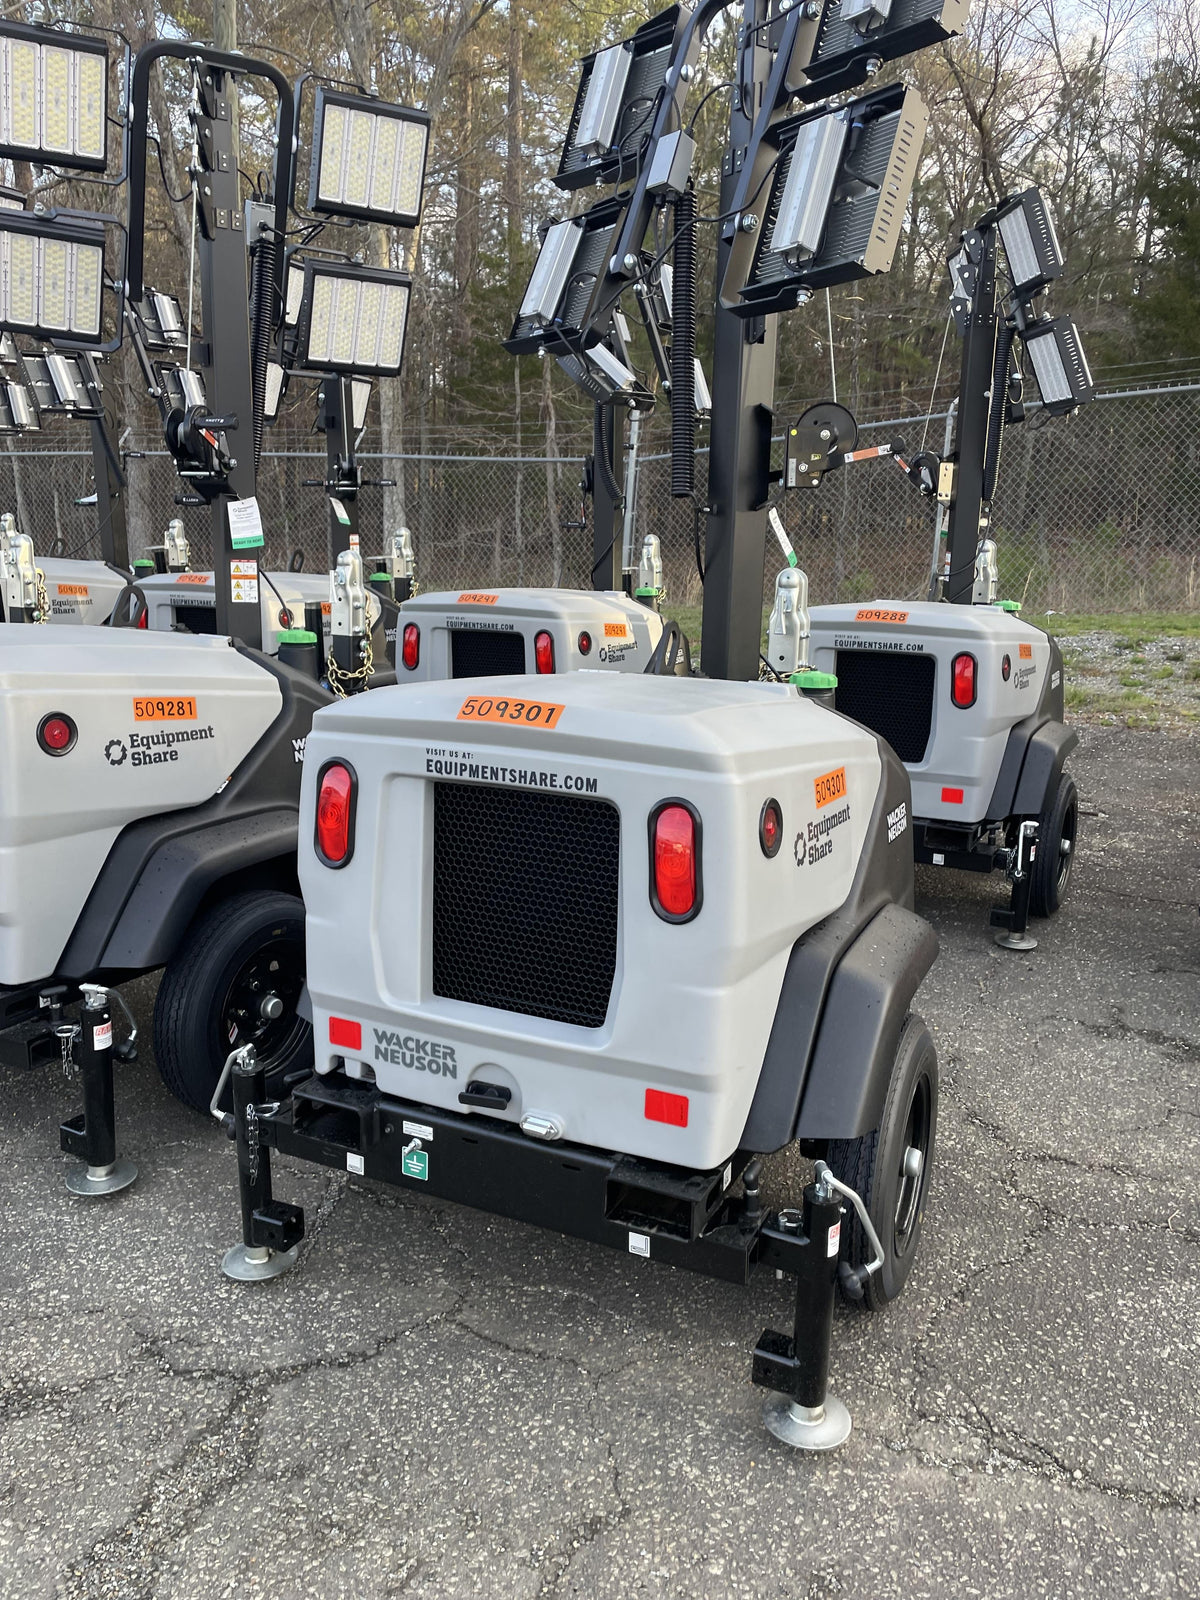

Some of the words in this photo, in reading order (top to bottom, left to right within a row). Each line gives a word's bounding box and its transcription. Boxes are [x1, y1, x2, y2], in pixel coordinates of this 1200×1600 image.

[460, 594, 497, 602] 509291
[446, 620, 514, 631] EQUIPMENTSHARE.COM
[857, 611, 907, 622] 509288
[605, 626, 625, 636] 509291
[834, 639, 924, 652] EQUIPMENTSHARE.COM
[608, 653, 626, 663] Share
[135, 700, 194, 718] 509281
[462, 699, 556, 724] 509301
[128, 725, 215, 749] Equipment
[131, 749, 179, 766] Share
[425, 747, 447, 757] VISIT
[449, 749, 459, 758] US
[461, 751, 475, 760] AT:
[425, 758, 599, 793] EQUIPMENTSHARE.COM
[815, 772, 845, 803] 509301
[807, 803, 851, 842] Equipment
[886, 802, 907, 829] WACKER
[888, 815, 908, 844] NEUSON
[808, 839, 833, 866] Share
[372, 1027, 457, 1063] WACKER
[374, 1044, 458, 1080] NEUSON
